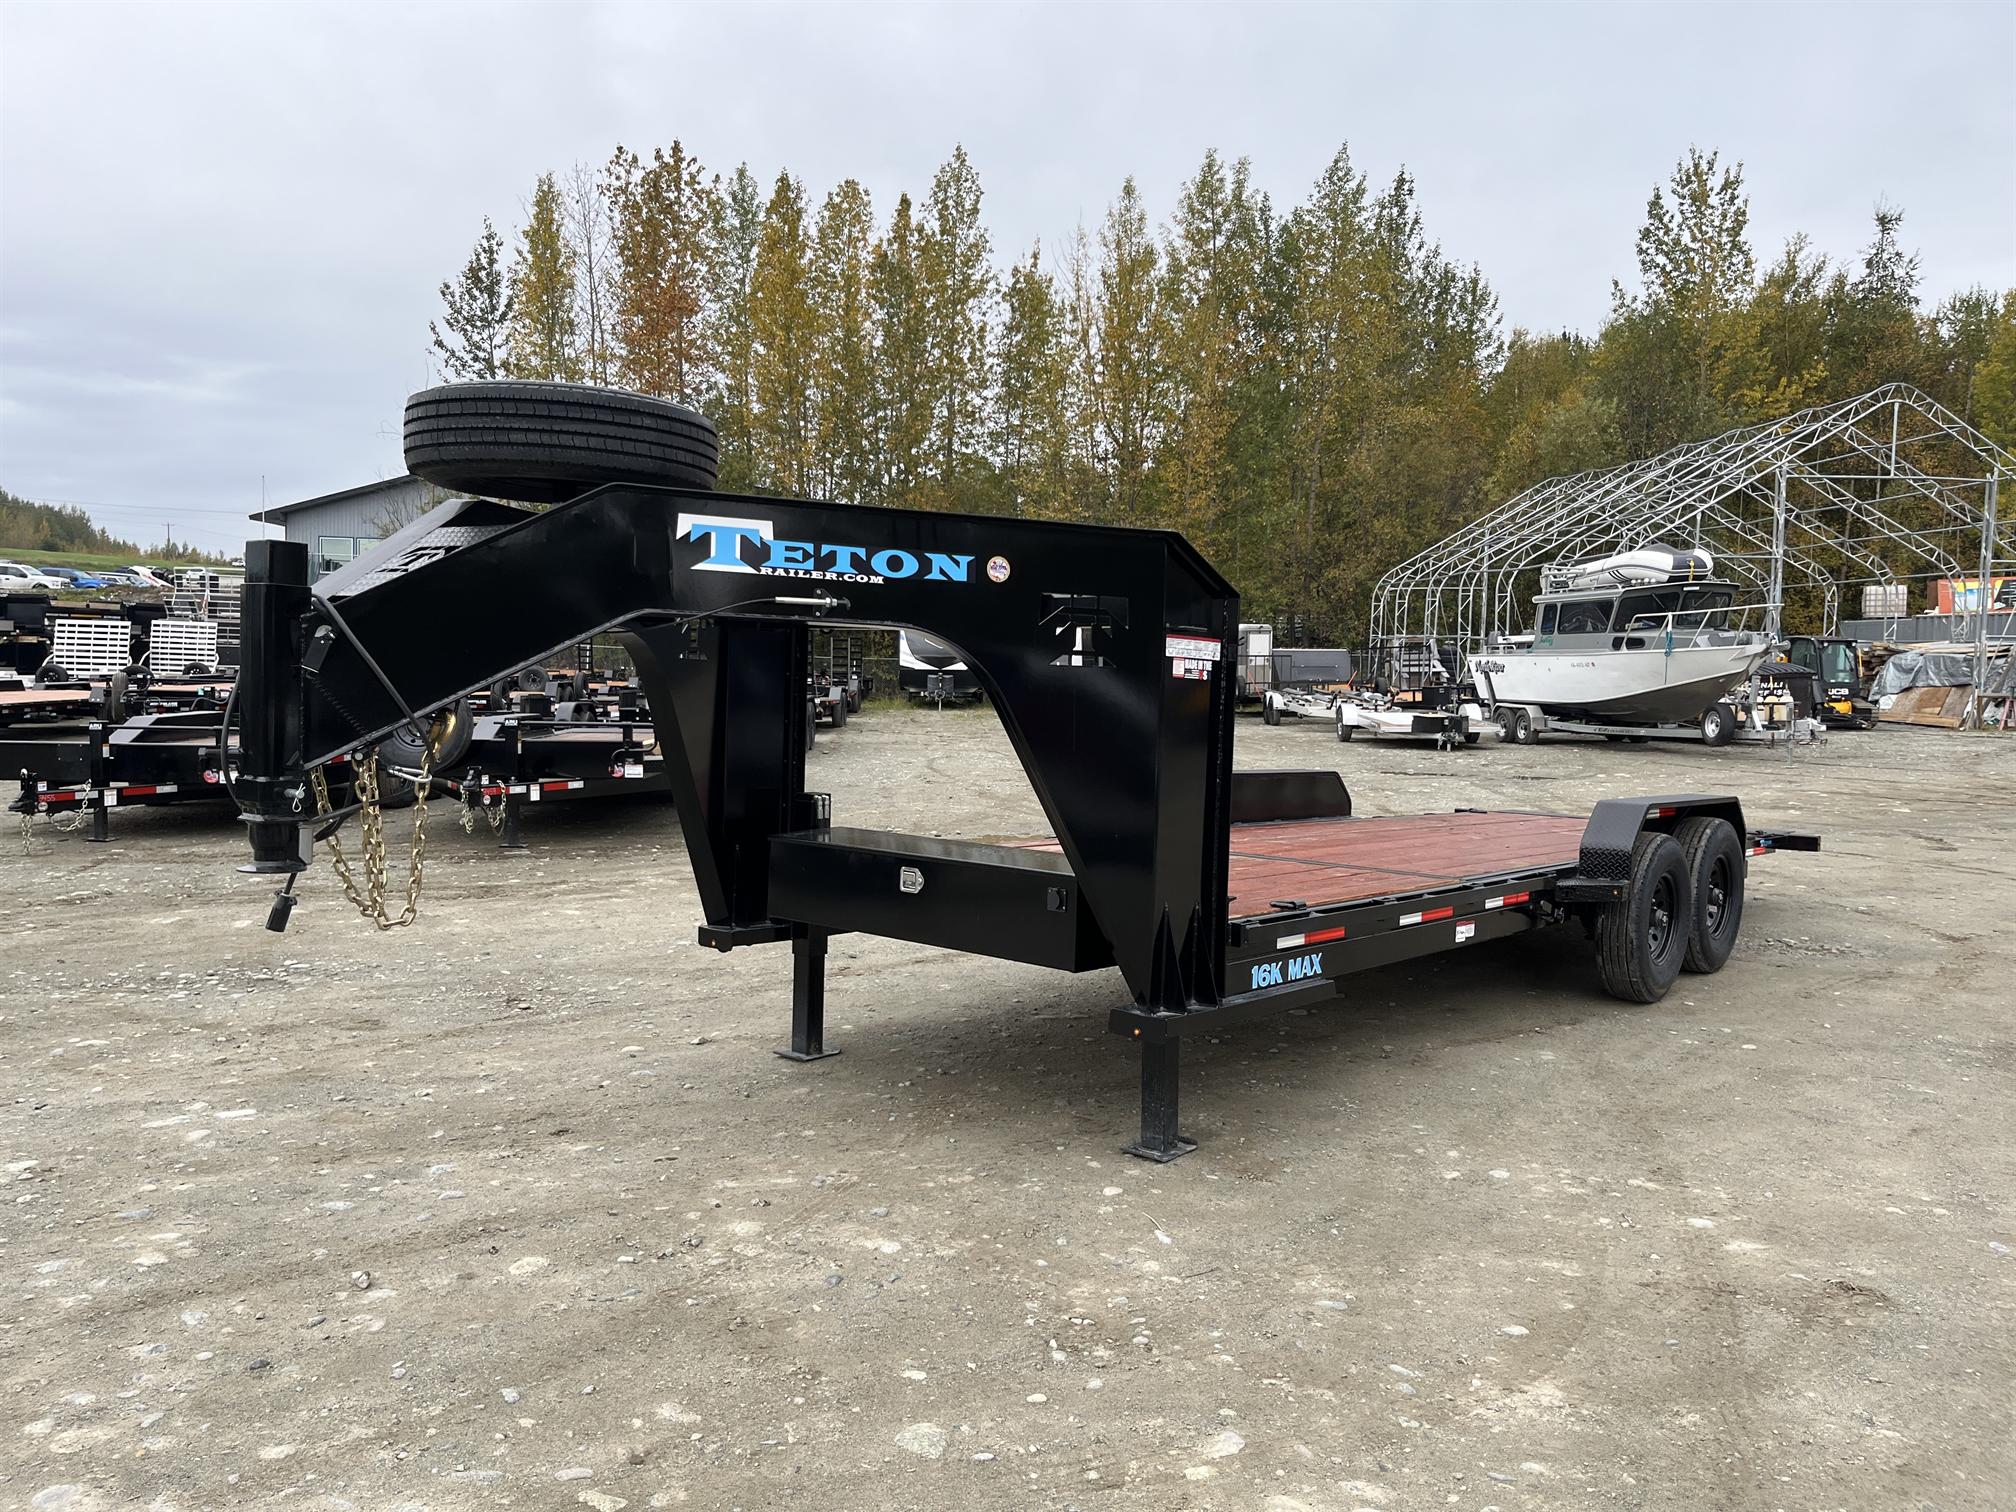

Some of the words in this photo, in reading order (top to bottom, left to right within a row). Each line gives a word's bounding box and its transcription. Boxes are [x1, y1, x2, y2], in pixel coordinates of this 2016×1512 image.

[676, 513, 976, 583] TETON
[1251, 961, 1284, 989] 16K
[1287, 952, 1323, 981] MAX
